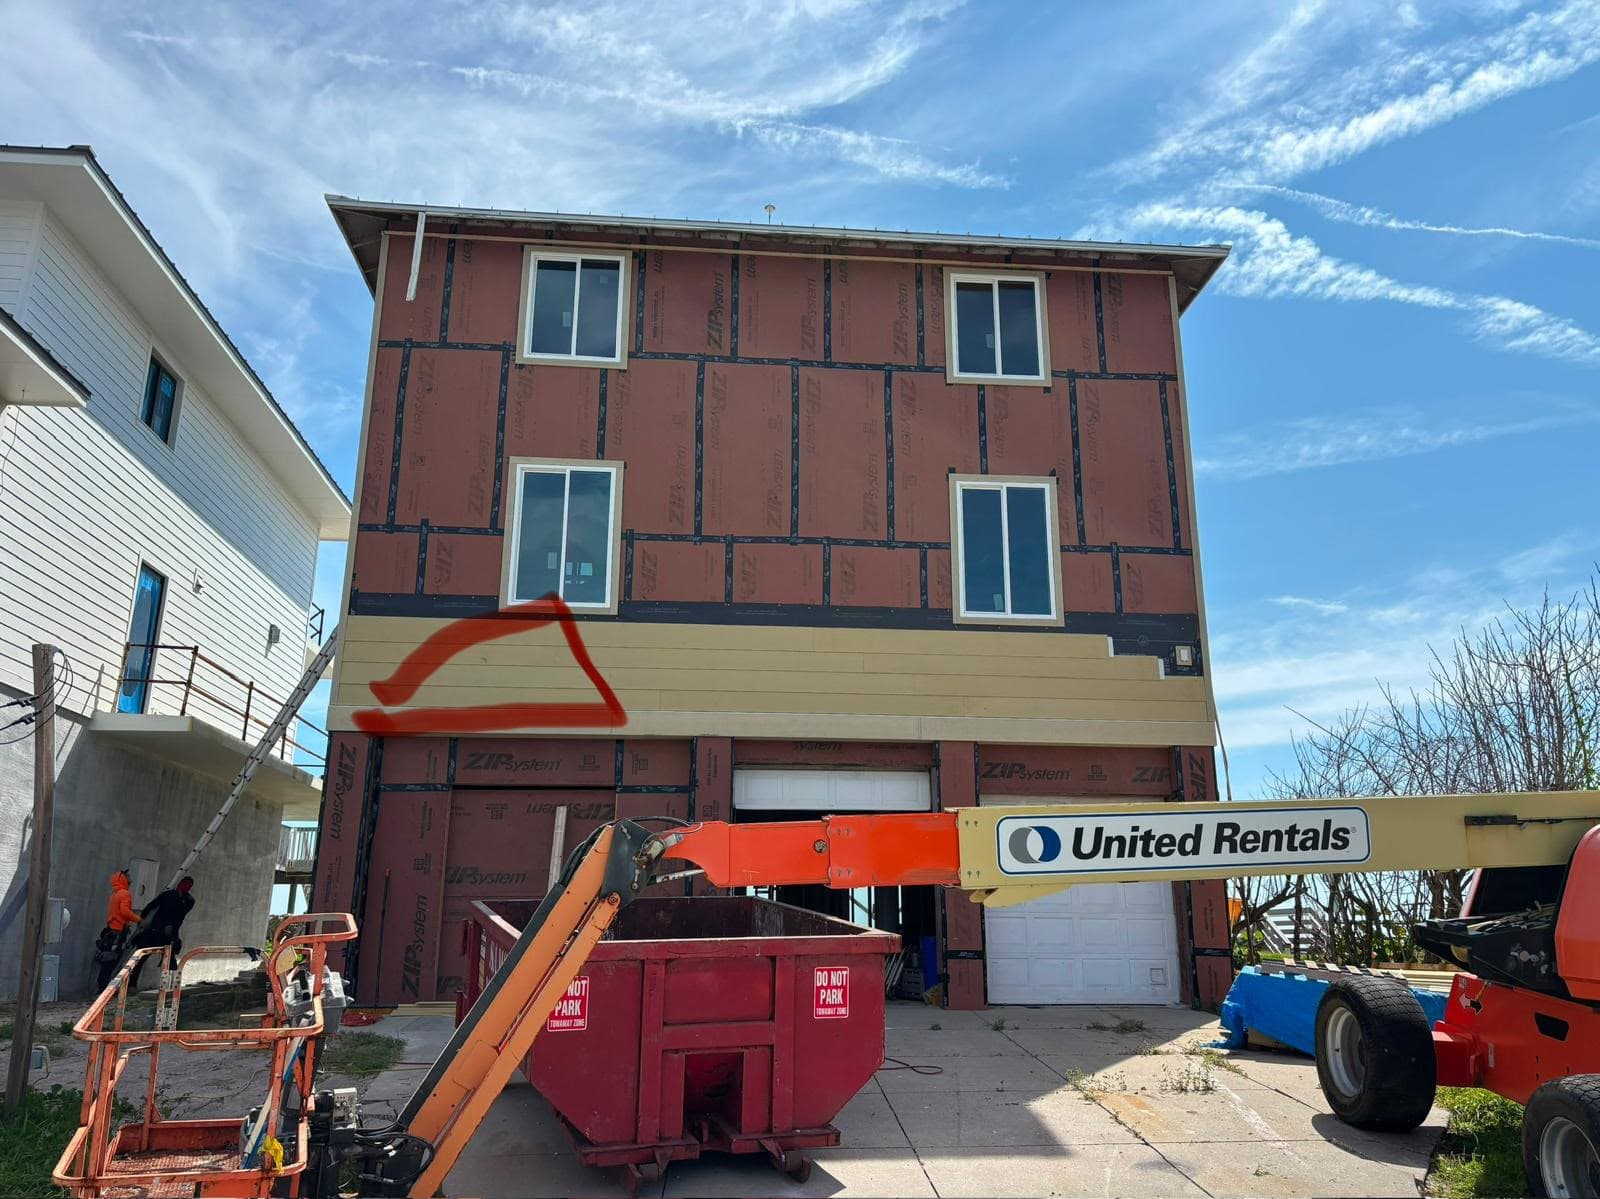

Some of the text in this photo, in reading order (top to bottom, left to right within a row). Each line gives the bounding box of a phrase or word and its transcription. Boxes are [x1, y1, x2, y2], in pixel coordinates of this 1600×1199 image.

[1072, 819, 1351, 860] United Rentals
[816, 971, 848, 987] DO NOT
[567, 980, 587, 997] NOT
[820, 989, 844, 1005] PARK
[554, 1000, 582, 1016] PARK
